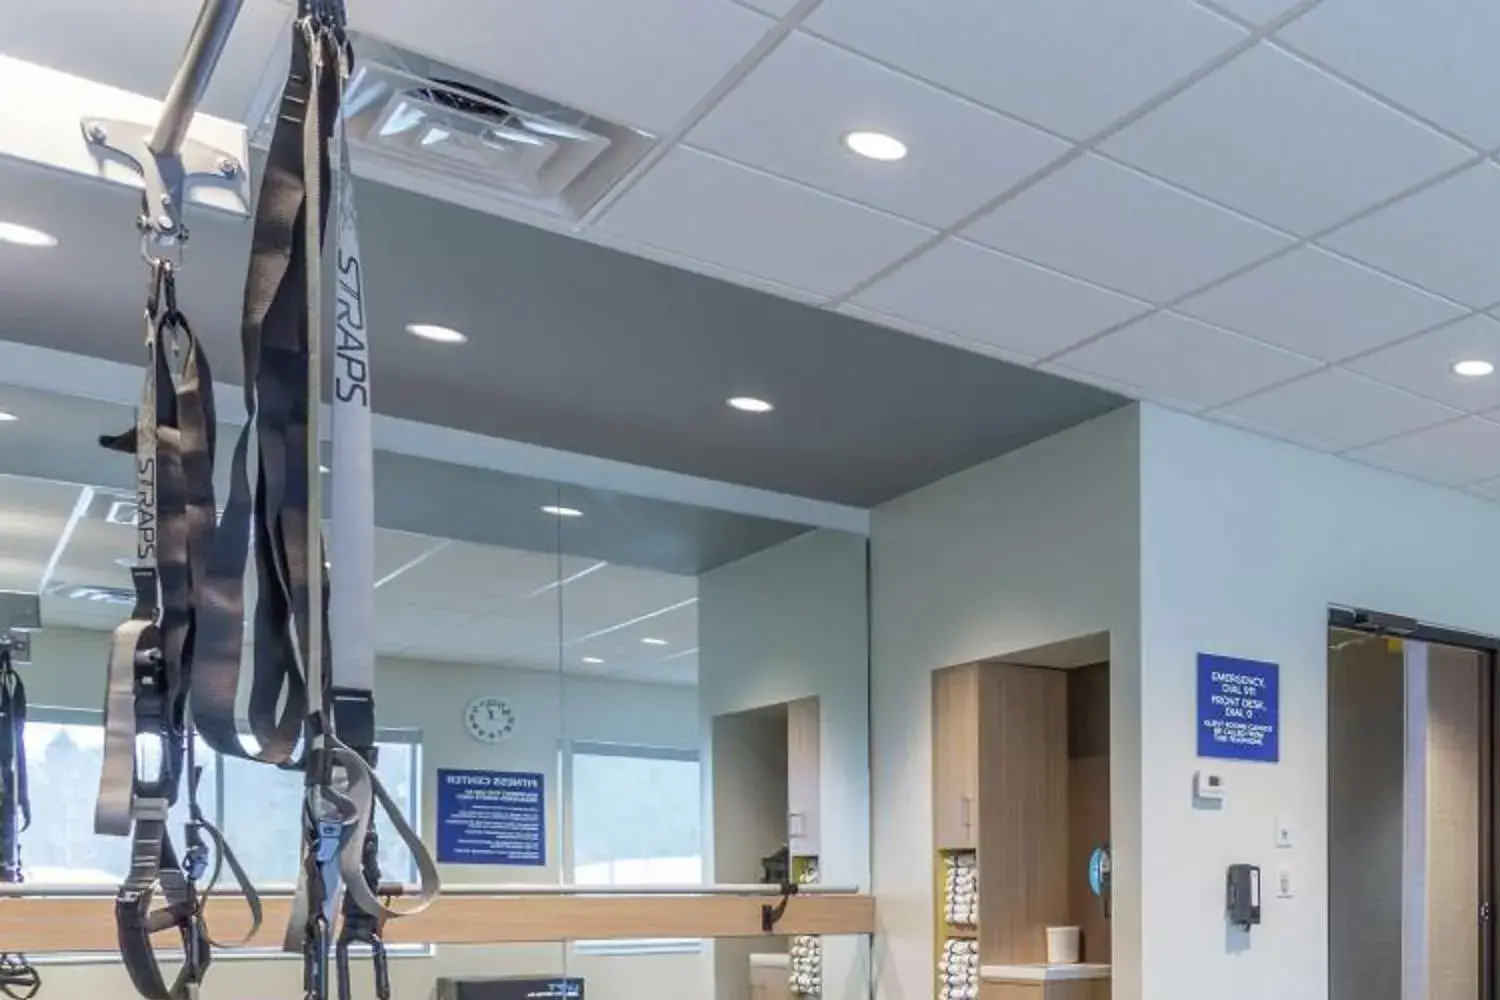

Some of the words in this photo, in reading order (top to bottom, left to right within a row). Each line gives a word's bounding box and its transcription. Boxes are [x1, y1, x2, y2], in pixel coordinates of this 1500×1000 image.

[335, 248, 367, 407] STRAPS
[138, 457, 156, 559] STRAPS
[1221, 683, 1242, 695] DIAL
[1211, 694, 1240, 706] FRONT
[1225, 707, 1244, 718] DIAL
